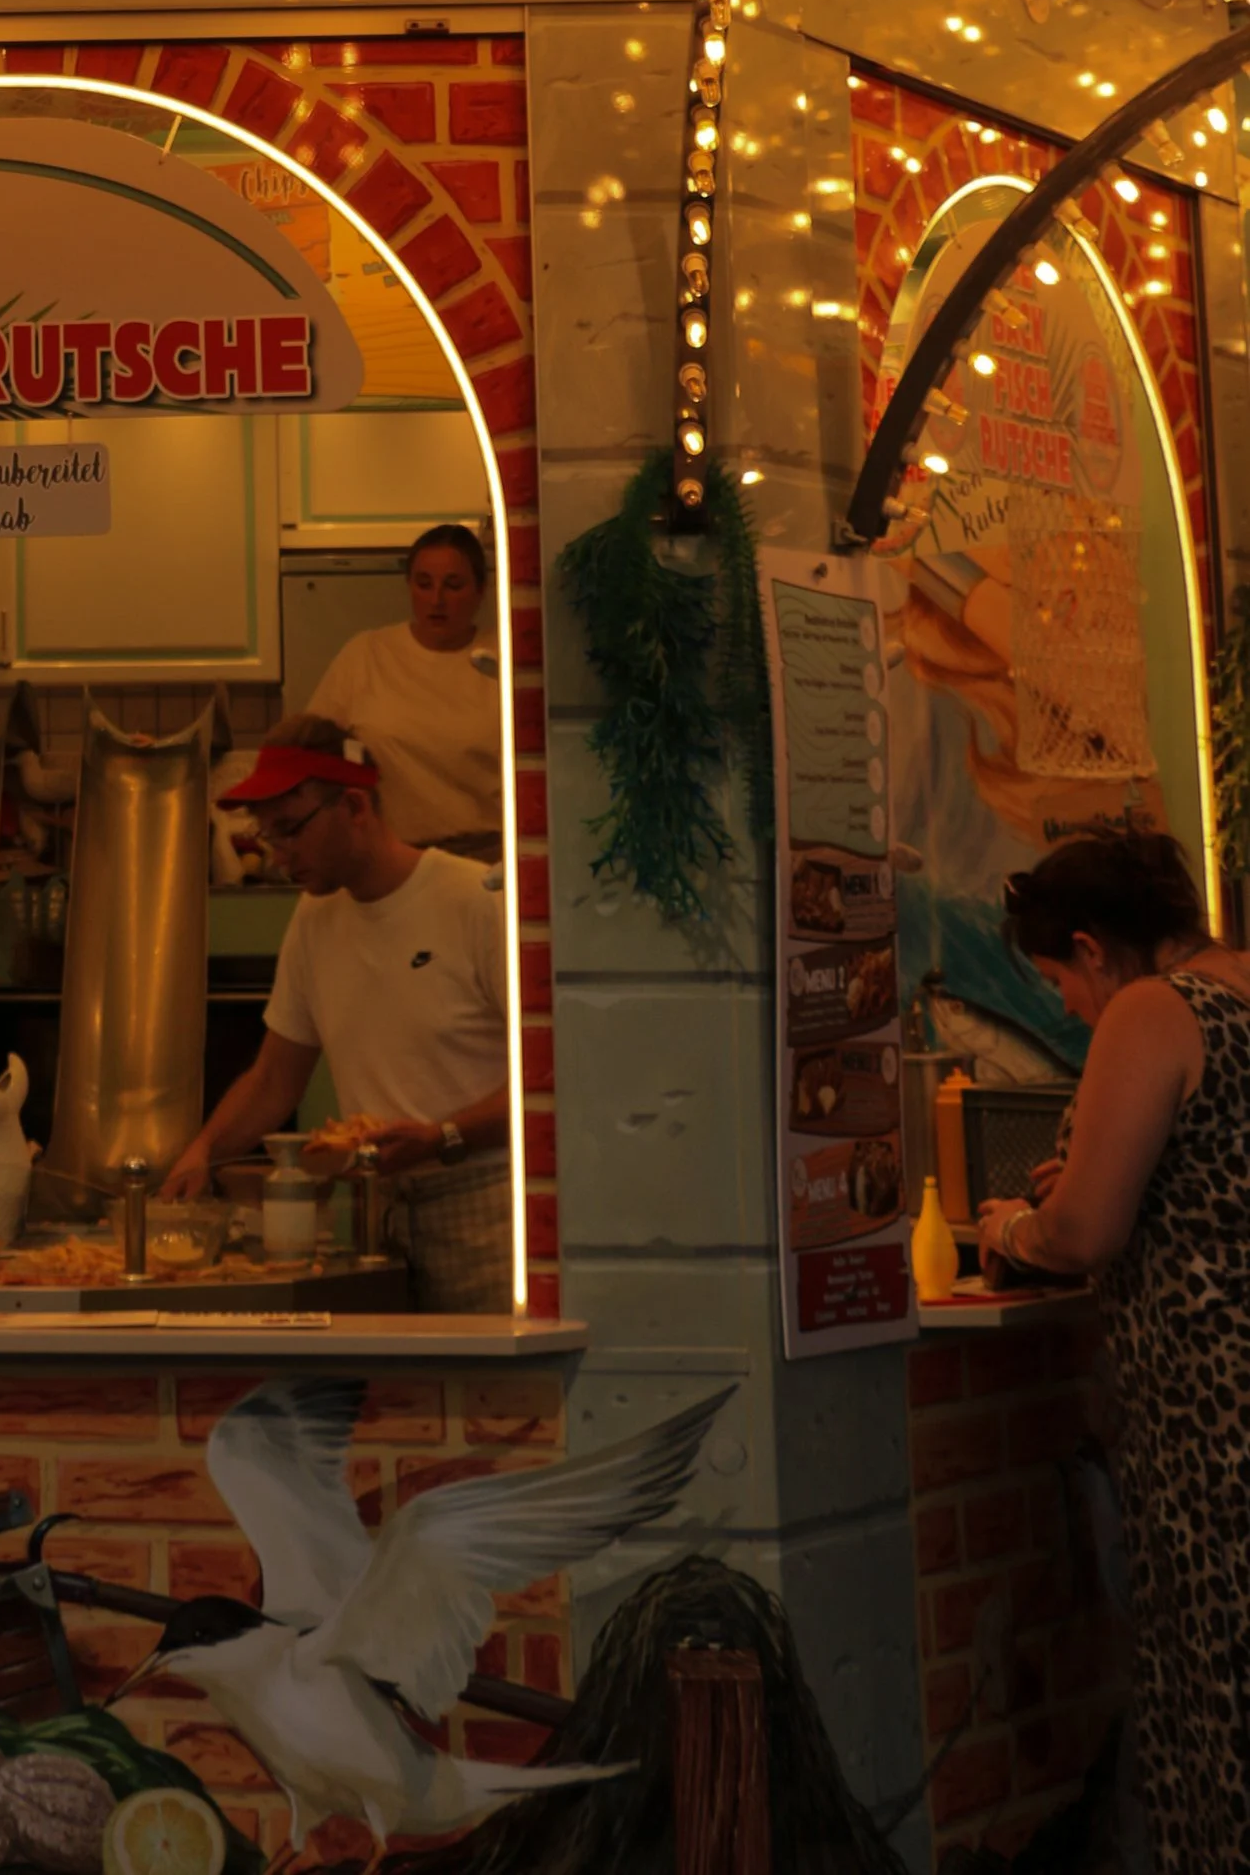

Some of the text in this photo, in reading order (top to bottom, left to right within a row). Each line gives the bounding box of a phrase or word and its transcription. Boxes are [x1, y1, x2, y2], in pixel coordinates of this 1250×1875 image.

[979, 411, 1073, 488] RUTSCHE
[806, 967, 836, 993] MENU
[807, 1177, 836, 1203] MENU
